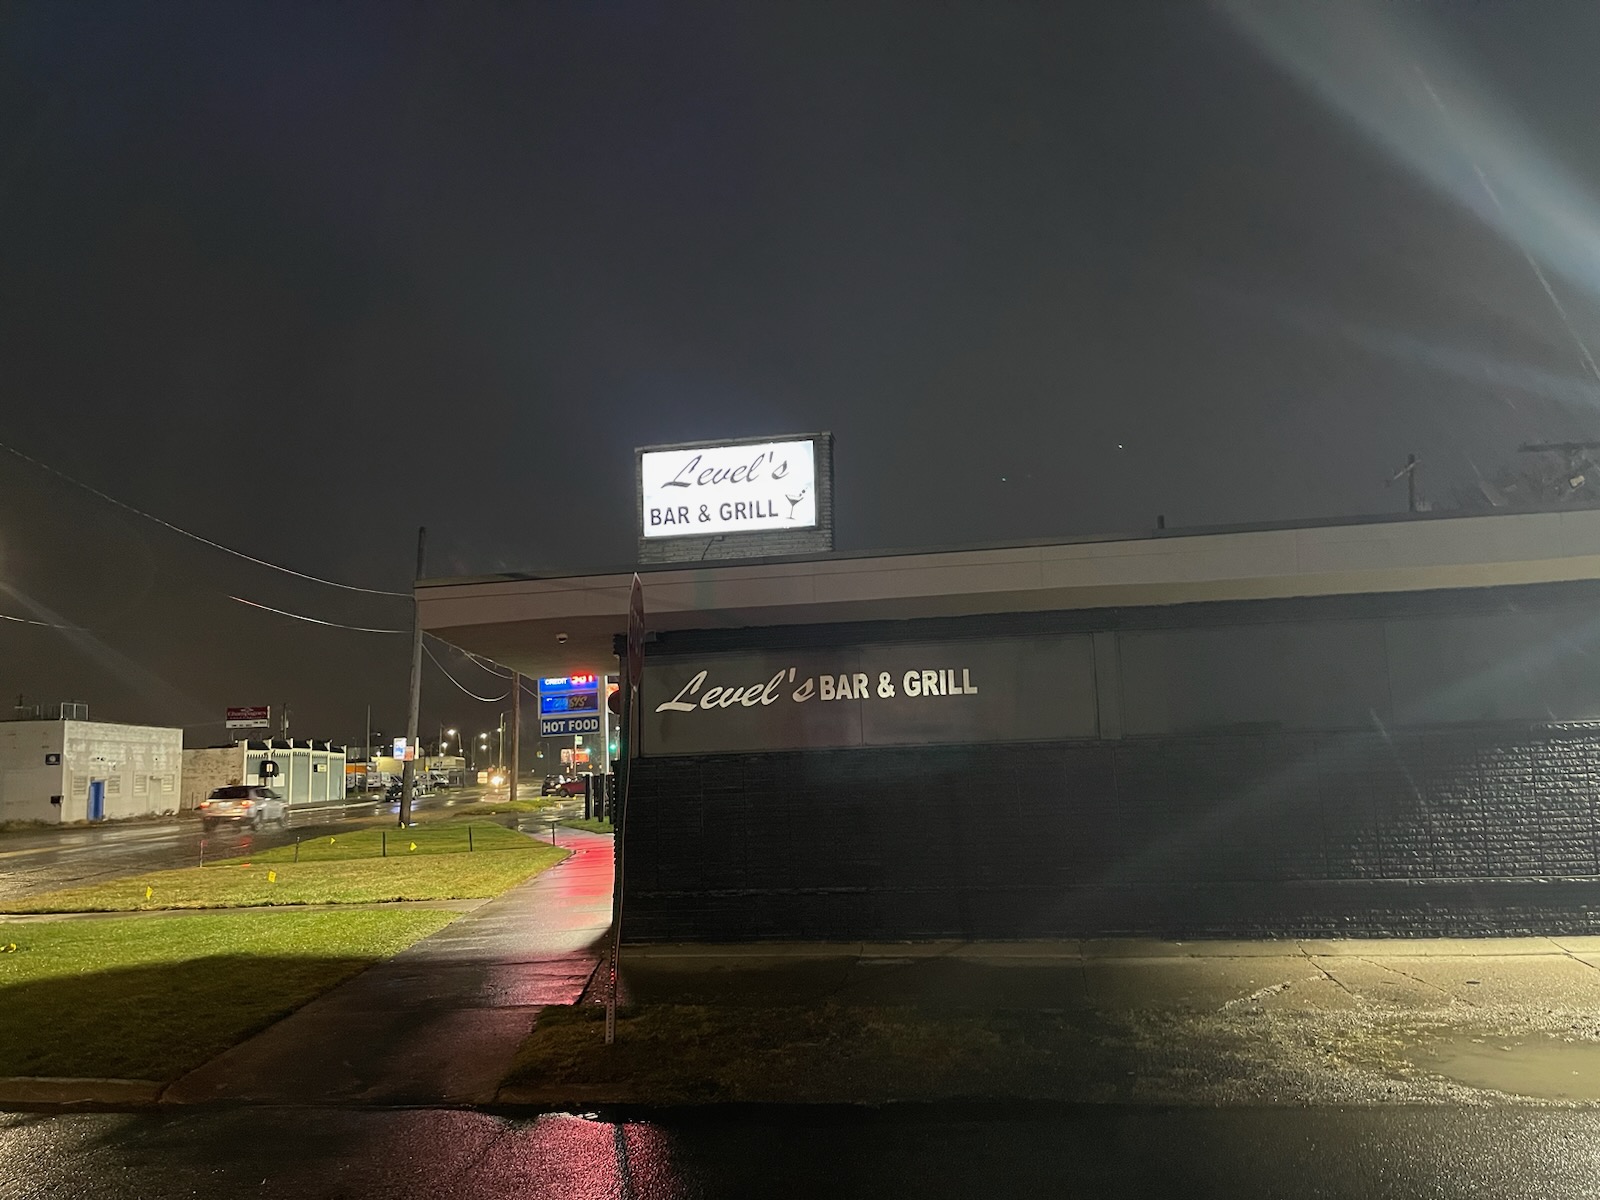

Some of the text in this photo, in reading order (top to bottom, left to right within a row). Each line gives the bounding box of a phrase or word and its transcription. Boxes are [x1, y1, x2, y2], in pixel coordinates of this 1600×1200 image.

[661, 451, 790, 489] Level's
[650, 499, 779, 526] BAR & GRILL
[655, 667, 978, 713] Level's BAR & GRILL
[543, 719, 599, 733] HOT FOOD
